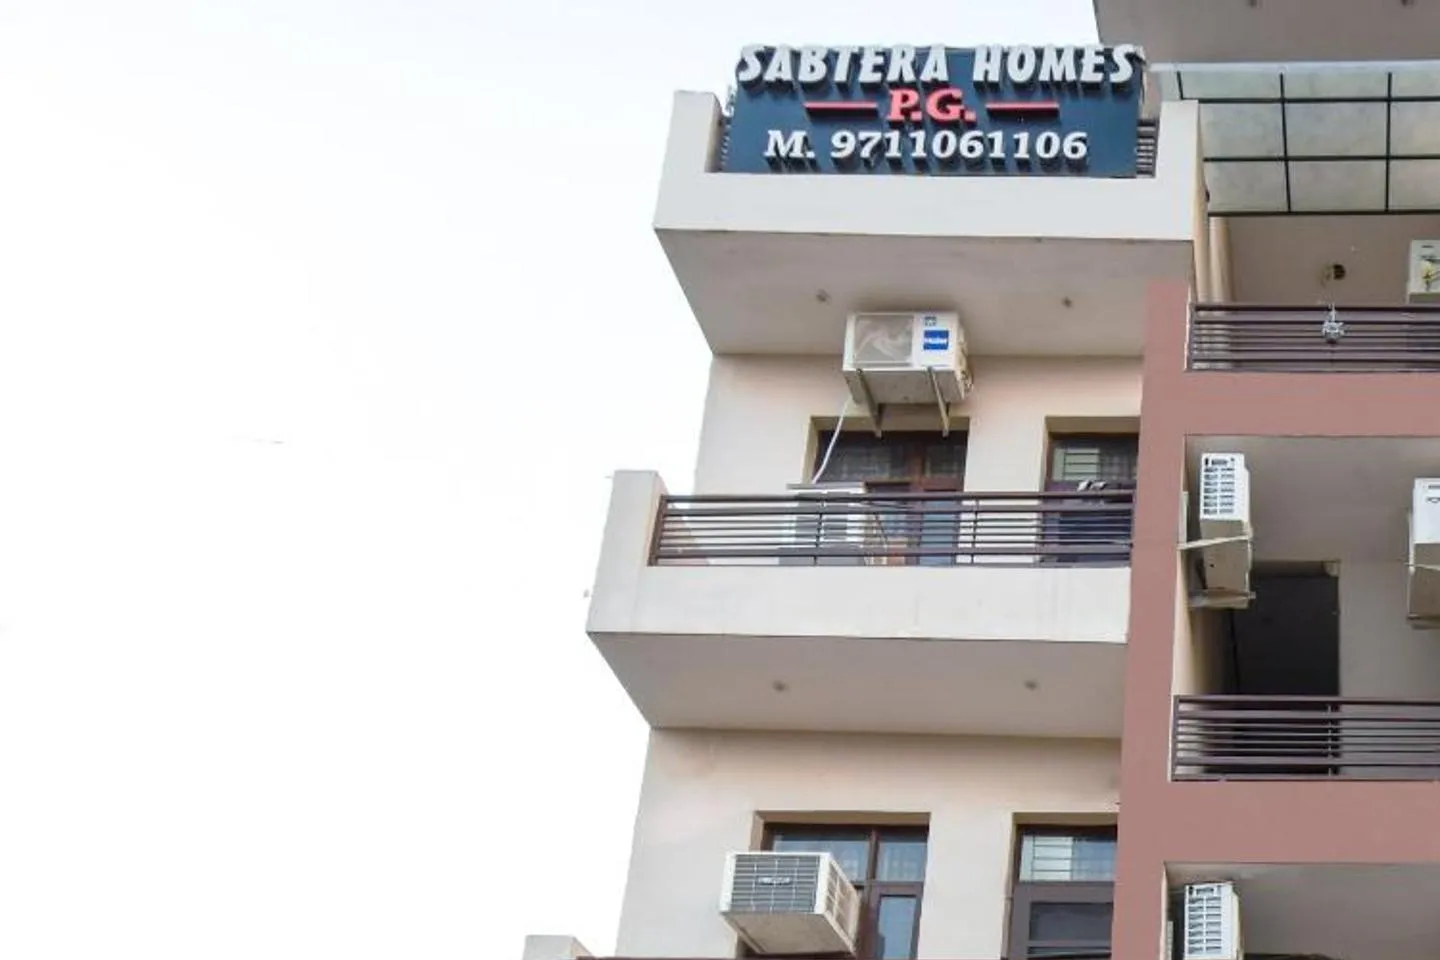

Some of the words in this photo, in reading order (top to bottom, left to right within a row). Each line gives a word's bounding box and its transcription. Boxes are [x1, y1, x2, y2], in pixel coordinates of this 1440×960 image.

[738, 43, 949, 83] SABTERA
[972, 43, 1136, 83] HOMES
[886, 87, 977, 122] P.G.
[764, 129, 816, 159] M.
[829, 129, 1088, 160] 9711061106
